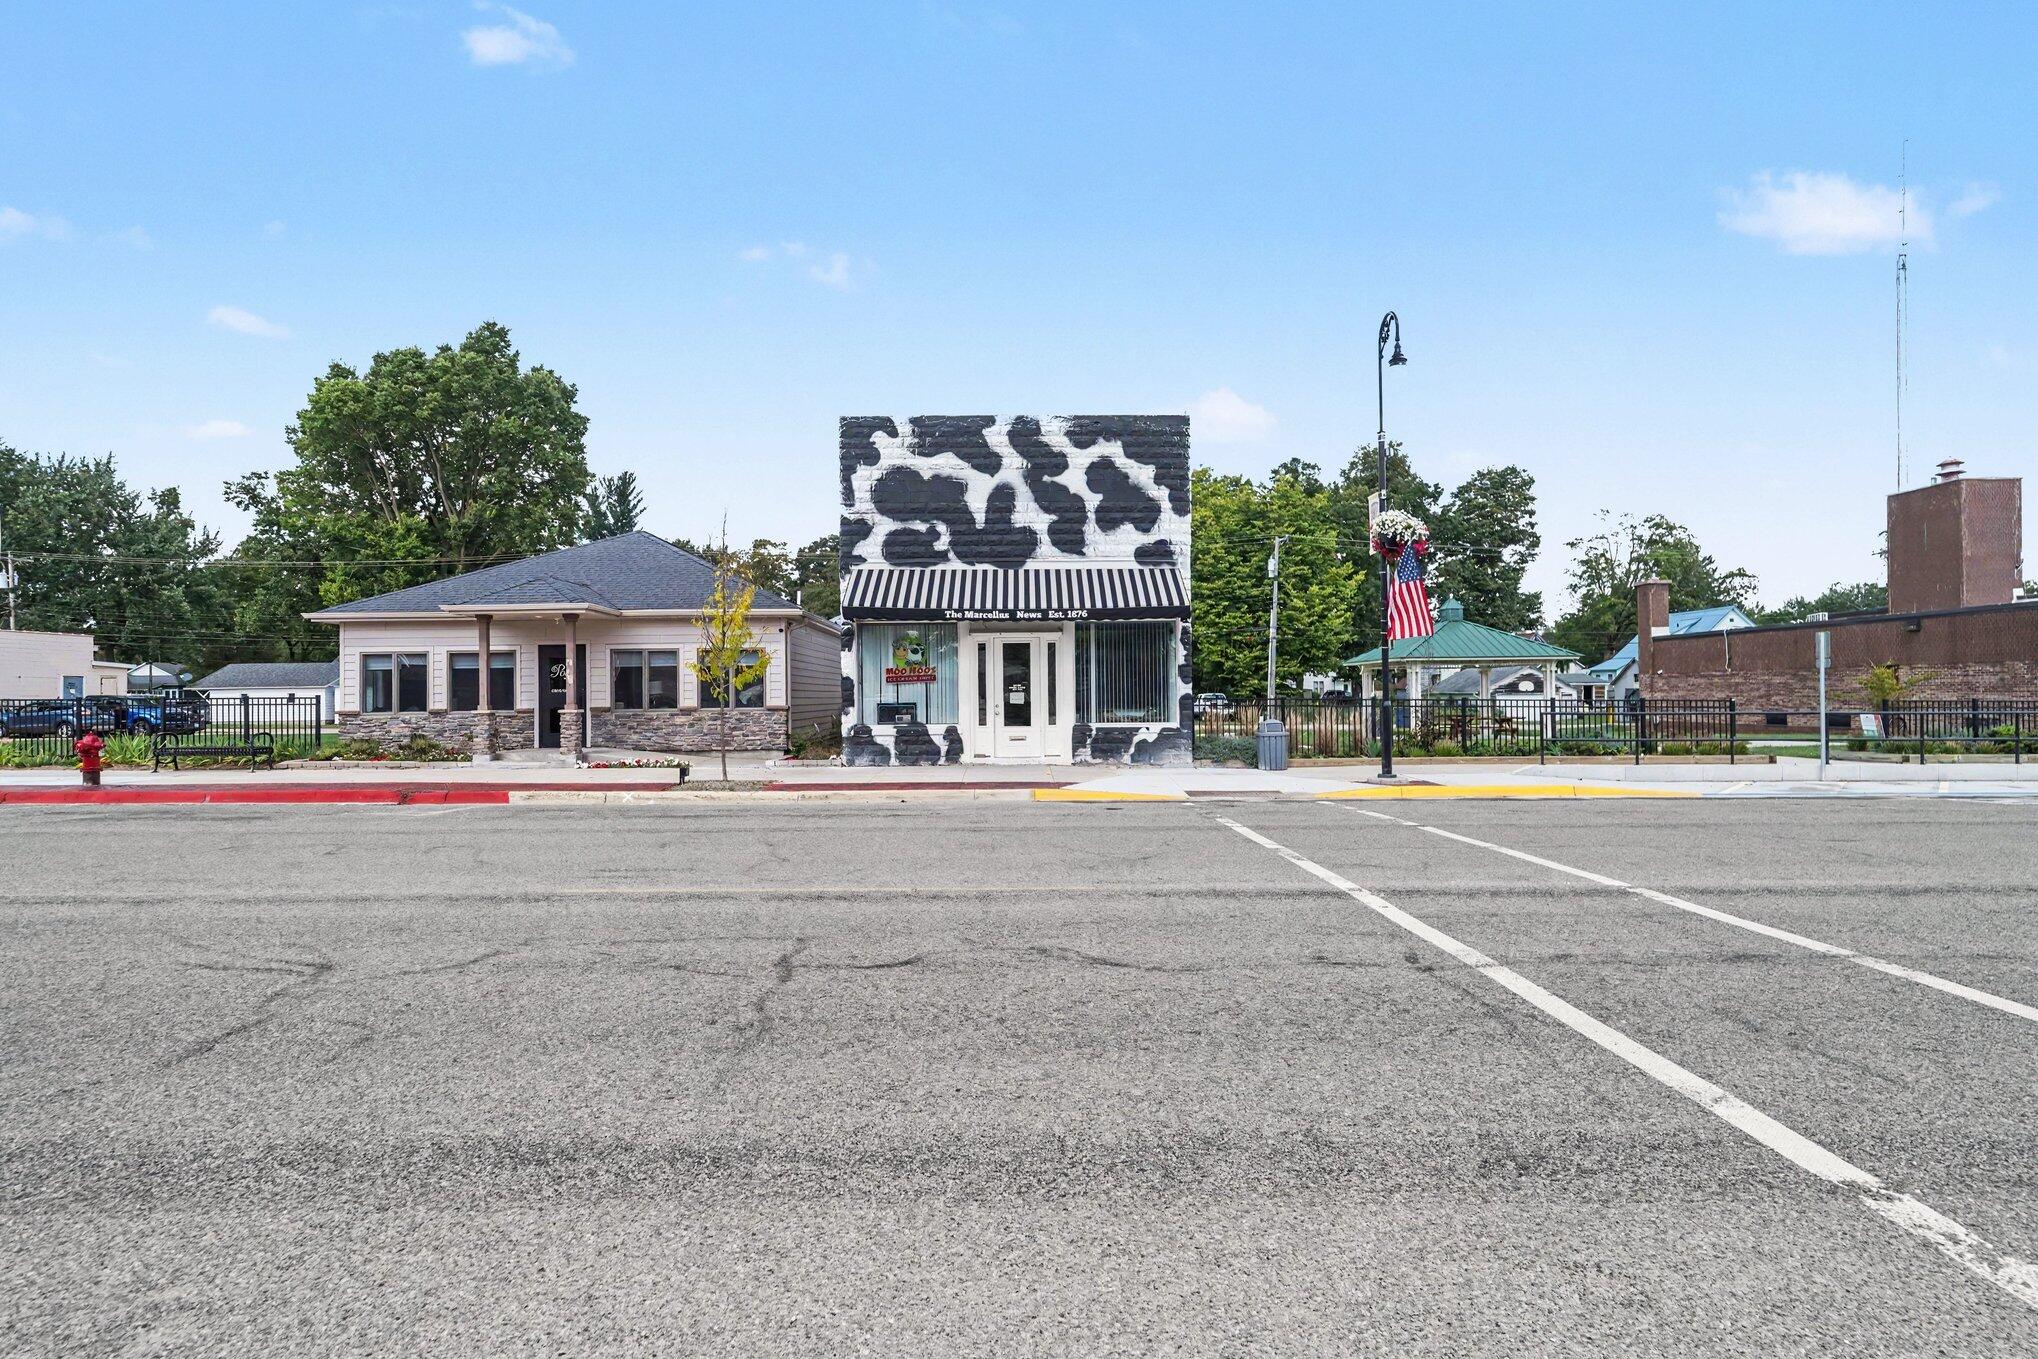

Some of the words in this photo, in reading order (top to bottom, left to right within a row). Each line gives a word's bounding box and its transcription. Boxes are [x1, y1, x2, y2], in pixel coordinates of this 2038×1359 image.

[945, 610, 963, 619] The
[964, 610, 1010, 619] Marcellus
[1016, 610, 1042, 619] News
[1067, 610, 1088, 618] 1876
